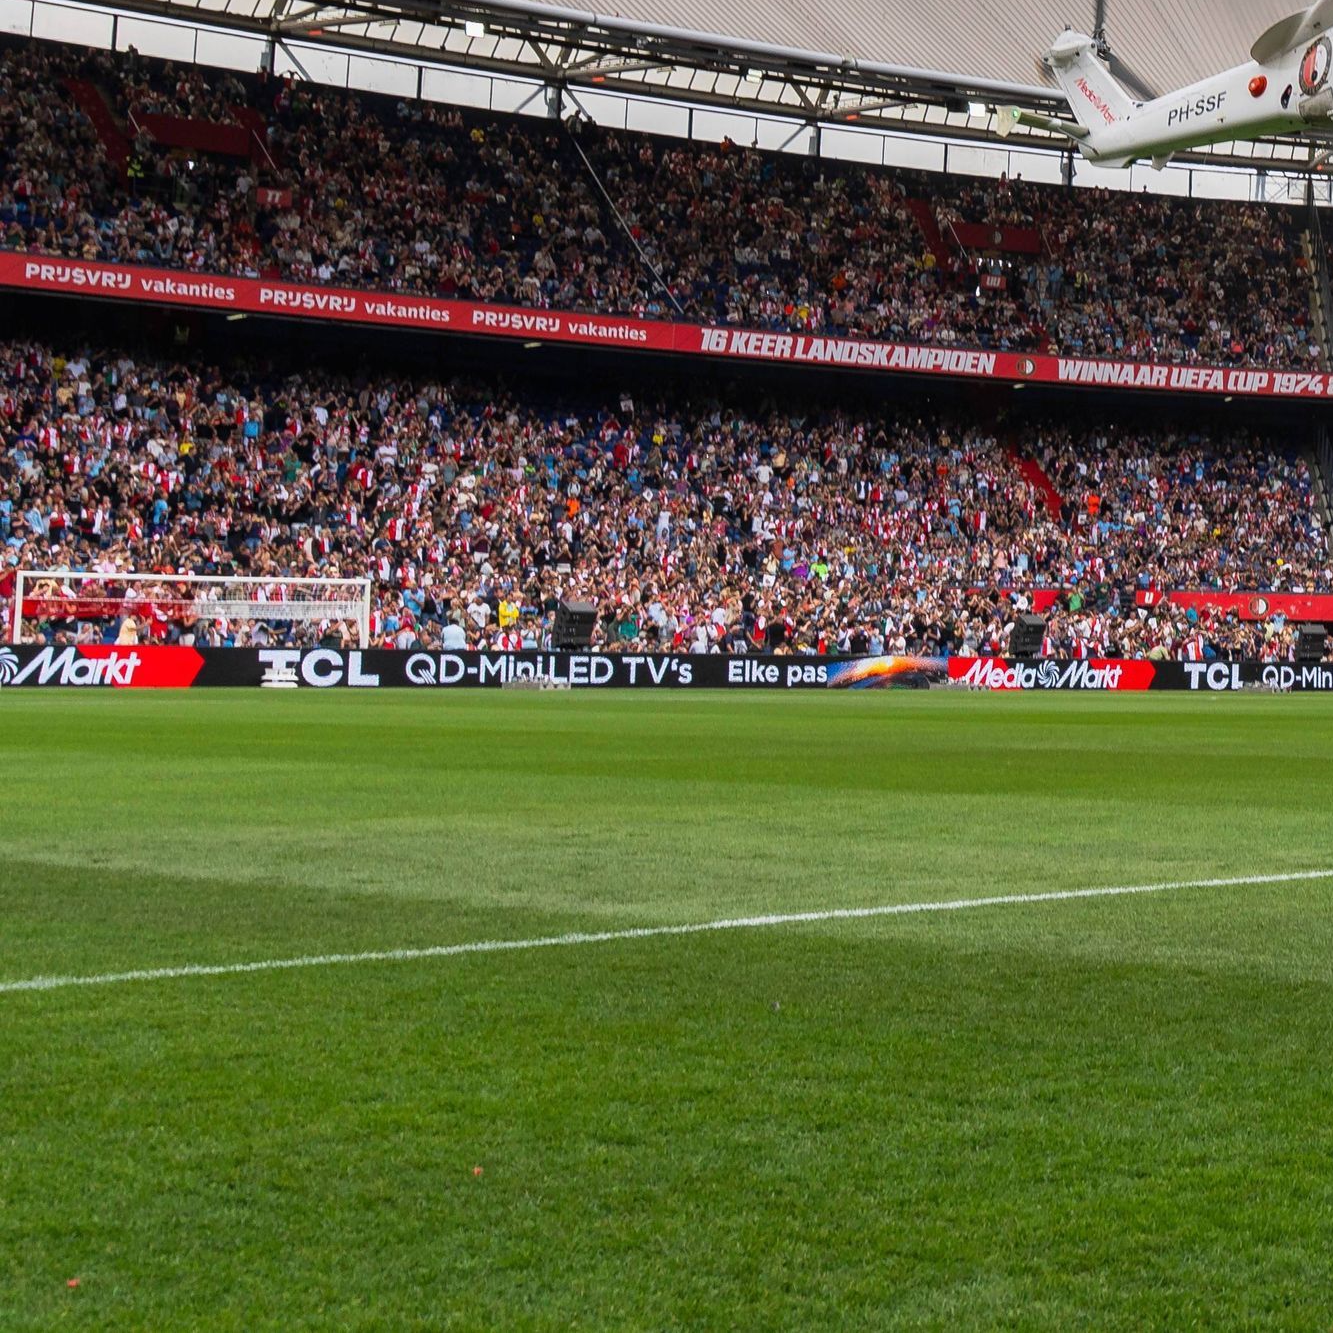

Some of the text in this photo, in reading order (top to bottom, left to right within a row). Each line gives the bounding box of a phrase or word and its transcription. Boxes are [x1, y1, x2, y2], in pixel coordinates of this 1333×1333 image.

[1167, 91, 1227, 127] PH-SSF
[141, 278, 235, 301] vakanties
[365, 301, 450, 322] vakanties
[568, 321, 647, 341] vakanties
[701, 327, 997, 375] 16 KEER LANDSKAMPIOEN
[1057, 359, 1167, 387] WINNAAR
[1170, 367, 1224, 391] UEFA
[1227, 370, 1268, 392] CUP
[1273, 372, 1323, 395] 1974
[11, 646, 141, 685] Markt
[259, 649, 379, 687] TCL
[728, 660, 828, 687] Elke pas
[964, 659, 1122, 688] Media Markt
